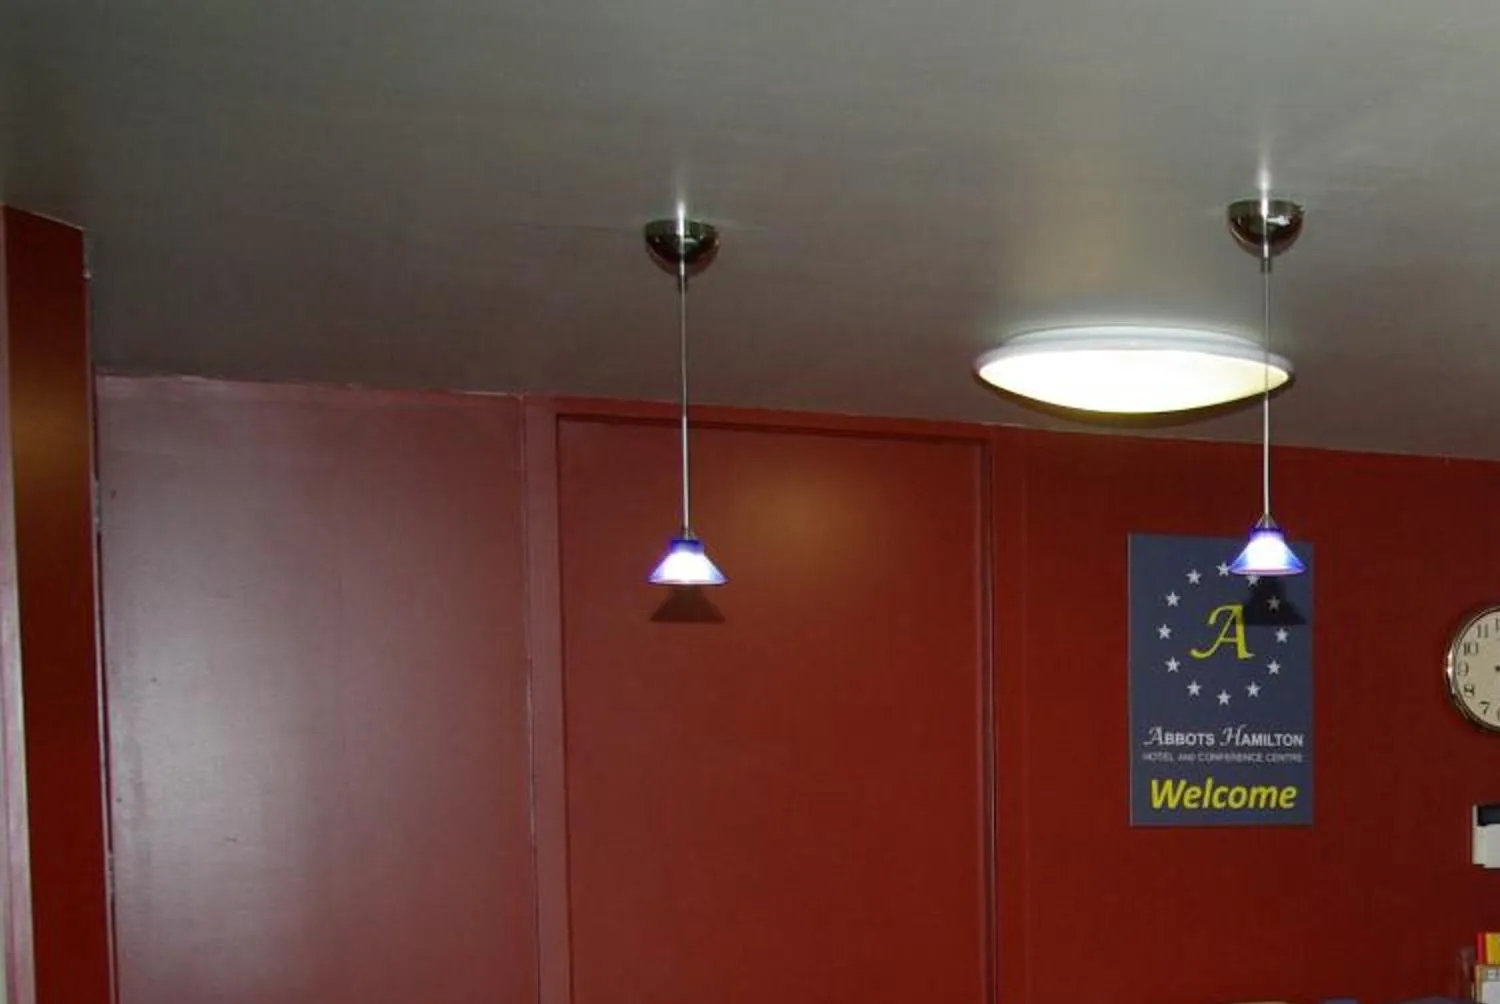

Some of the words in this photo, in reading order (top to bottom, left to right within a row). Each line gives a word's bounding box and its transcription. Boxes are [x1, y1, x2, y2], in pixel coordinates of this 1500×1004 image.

[1190, 604, 1255, 659] A
[1477, 623, 1488, 638] 11
[1463, 641, 1479, 656] 10
[1458, 662, 1469, 676] 9
[1480, 701, 1490, 715] 7
[1219, 724, 1304, 747] HAMILTON
[1142, 752, 1174, 762] HOTEL
[1177, 753, 1196, 762] AND
[1199, 752, 1264, 763] CONFERENCE
[1265, 753, 1303, 763] CENTRE
[1151, 776, 1298, 810] Welcome
